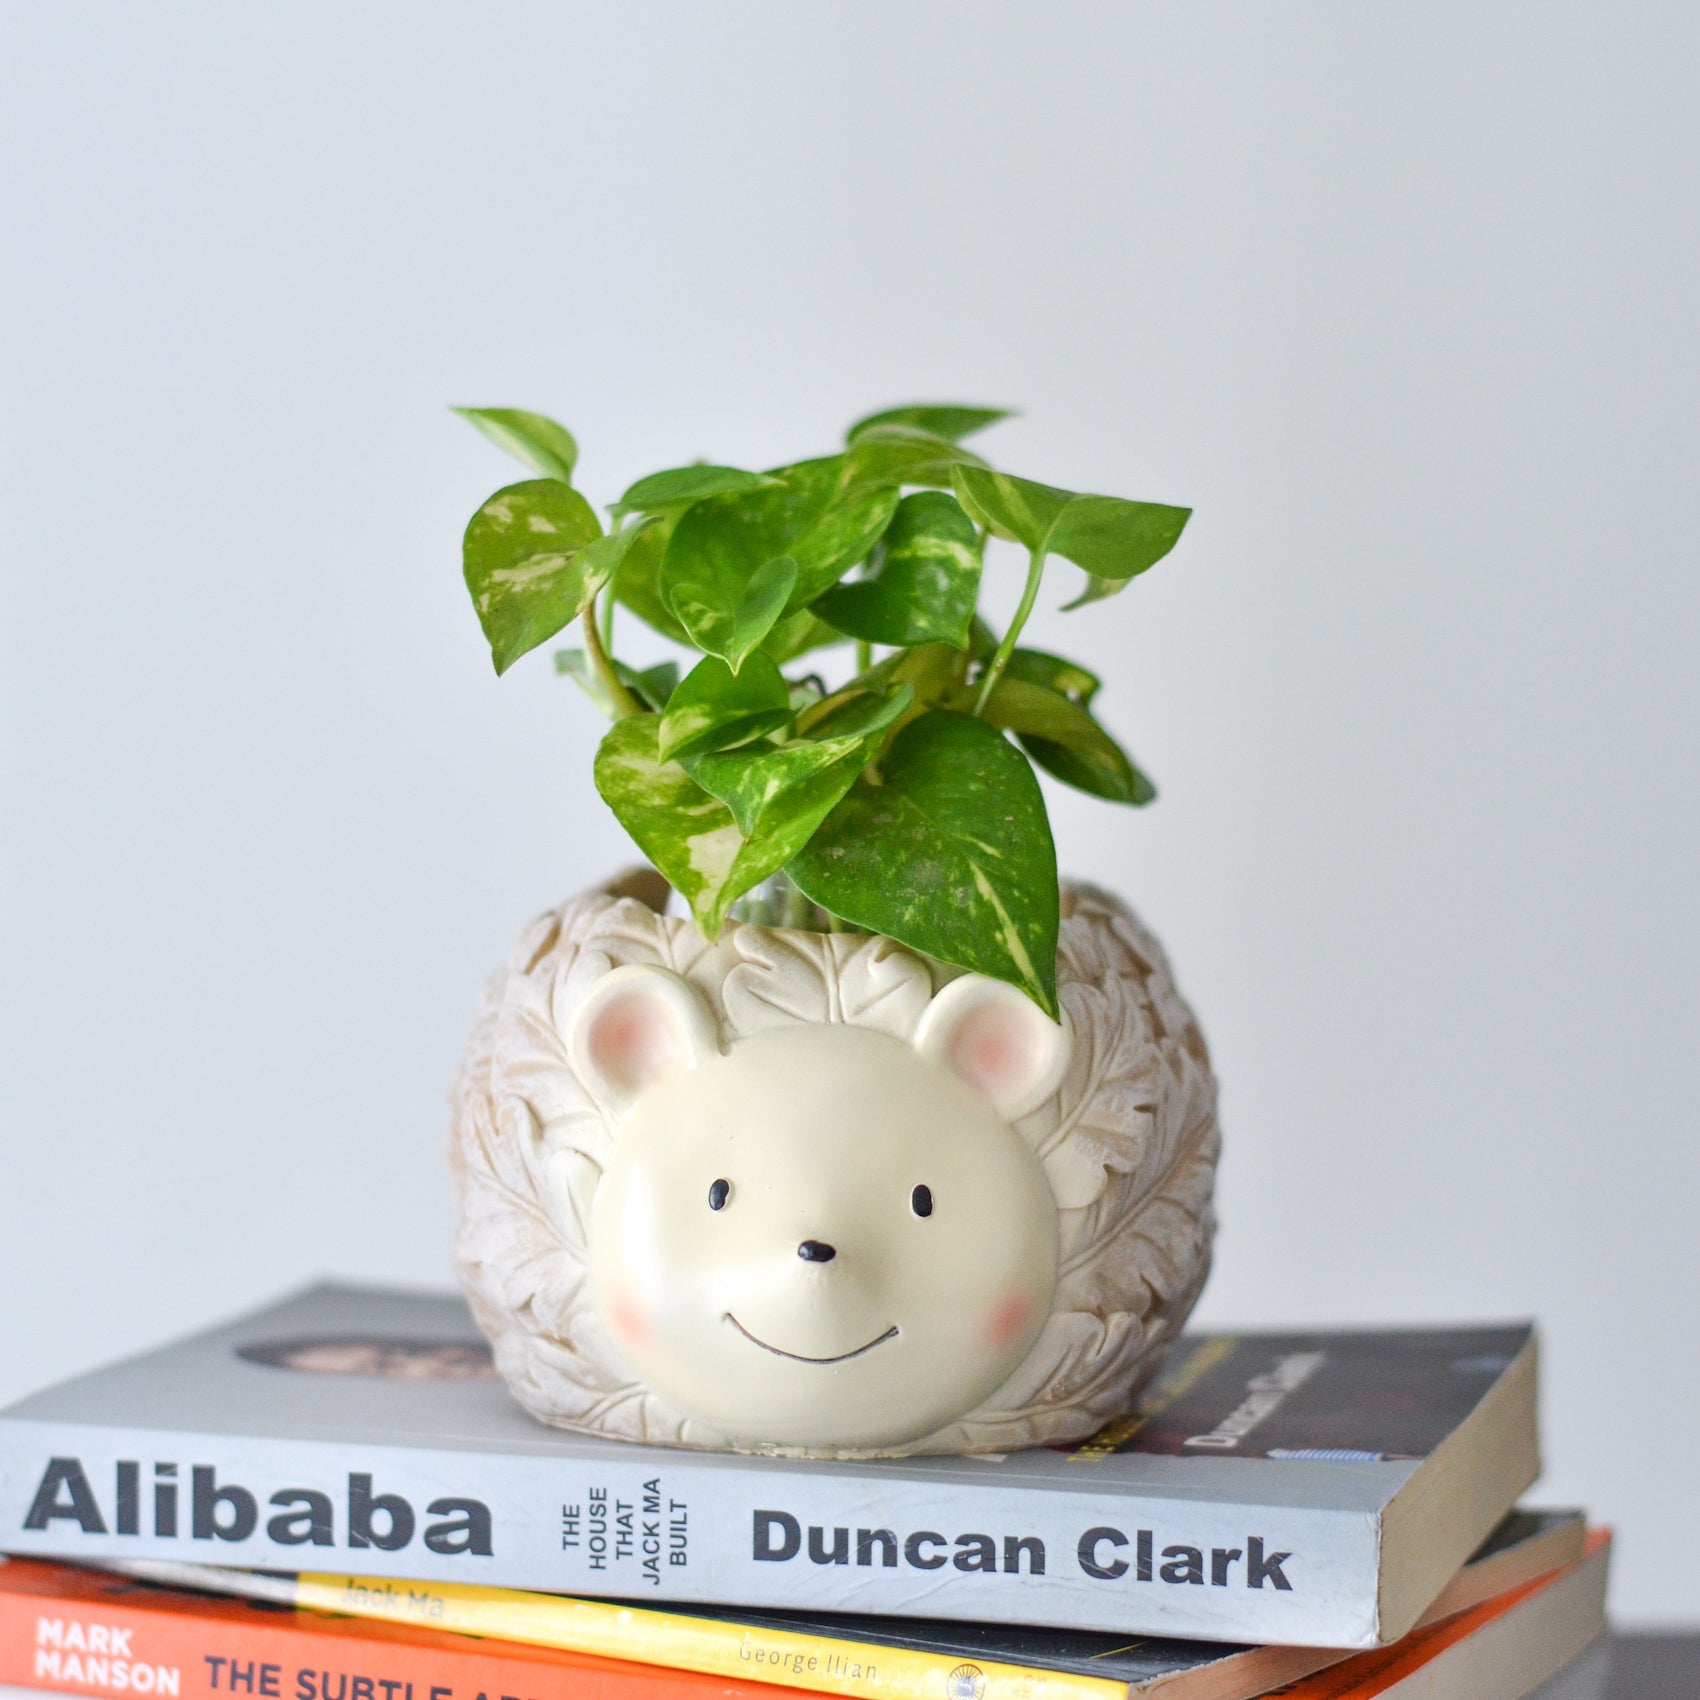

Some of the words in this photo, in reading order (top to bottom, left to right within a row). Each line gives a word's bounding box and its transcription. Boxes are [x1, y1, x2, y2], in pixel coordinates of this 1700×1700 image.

[24, 1456, 494, 1556] Alibaba
[642, 1477, 661, 1513] MA
[562, 1504, 580, 1550] THE
[588, 1487, 607, 1570] HOUSE
[615, 1499, 634, 1560] THAT
[669, 1498, 688, 1566] BUILT
[752, 1509, 1046, 1576] Duncan
[1077, 1526, 1293, 1592] Clark
[642, 1521, 660, 1586] JACK
[342, 1578, 399, 1610] Jack
[408, 1590, 445, 1619] Ma
[37, 1616, 133, 1657] MARK
[739, 1640, 818, 1674] George
[35, 1648, 181, 1696] MANSON
[204, 1655, 282, 1697] THE
